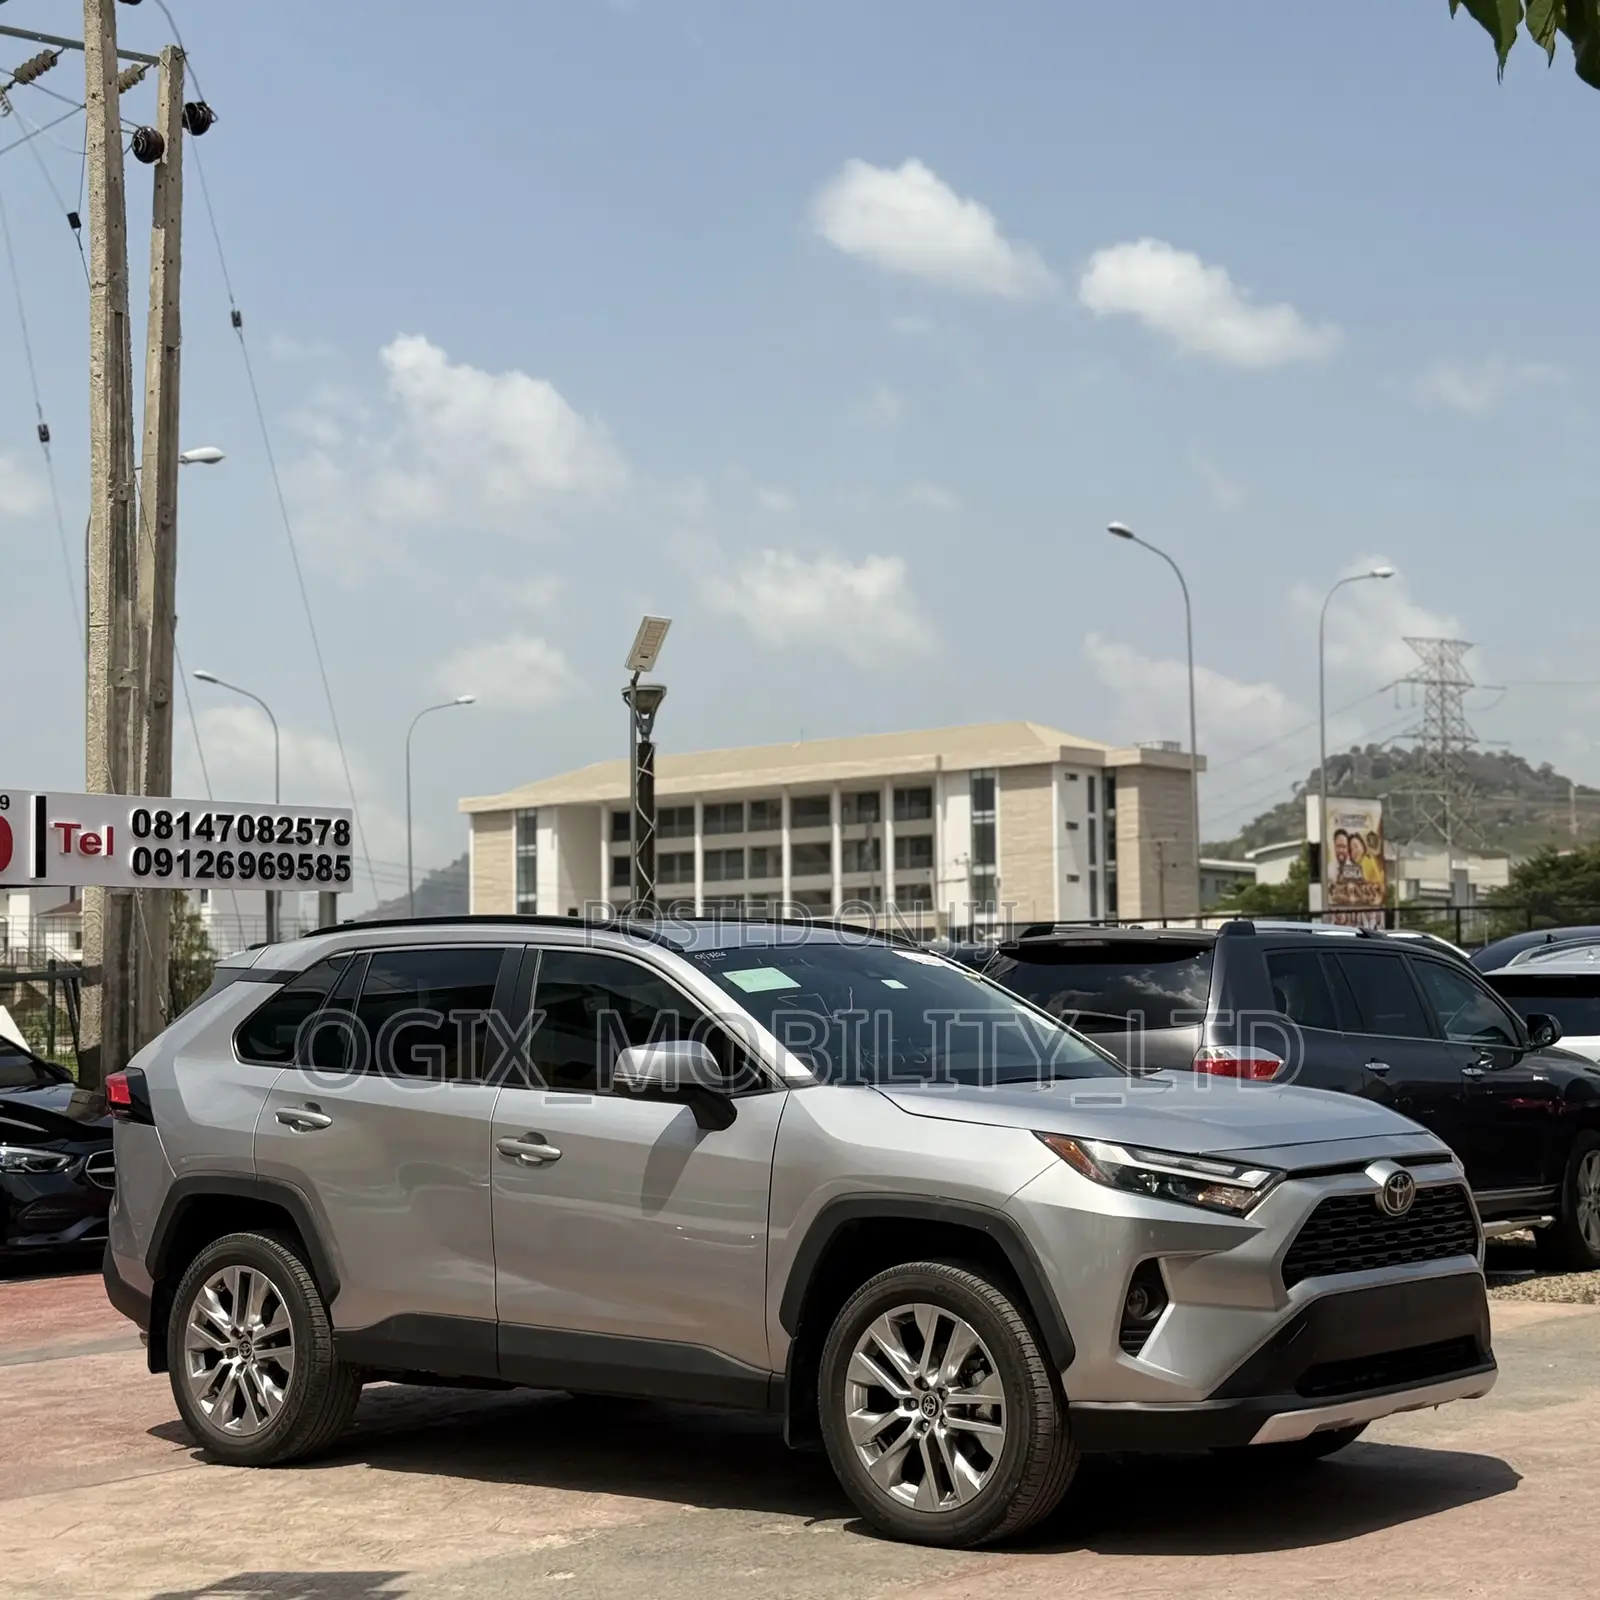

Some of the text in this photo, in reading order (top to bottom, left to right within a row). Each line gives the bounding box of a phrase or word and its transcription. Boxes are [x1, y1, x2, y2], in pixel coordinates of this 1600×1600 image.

[53, 822, 114, 856] Tel
[131, 808, 350, 846] 08147082578
[131, 847, 351, 882] 09126969585
